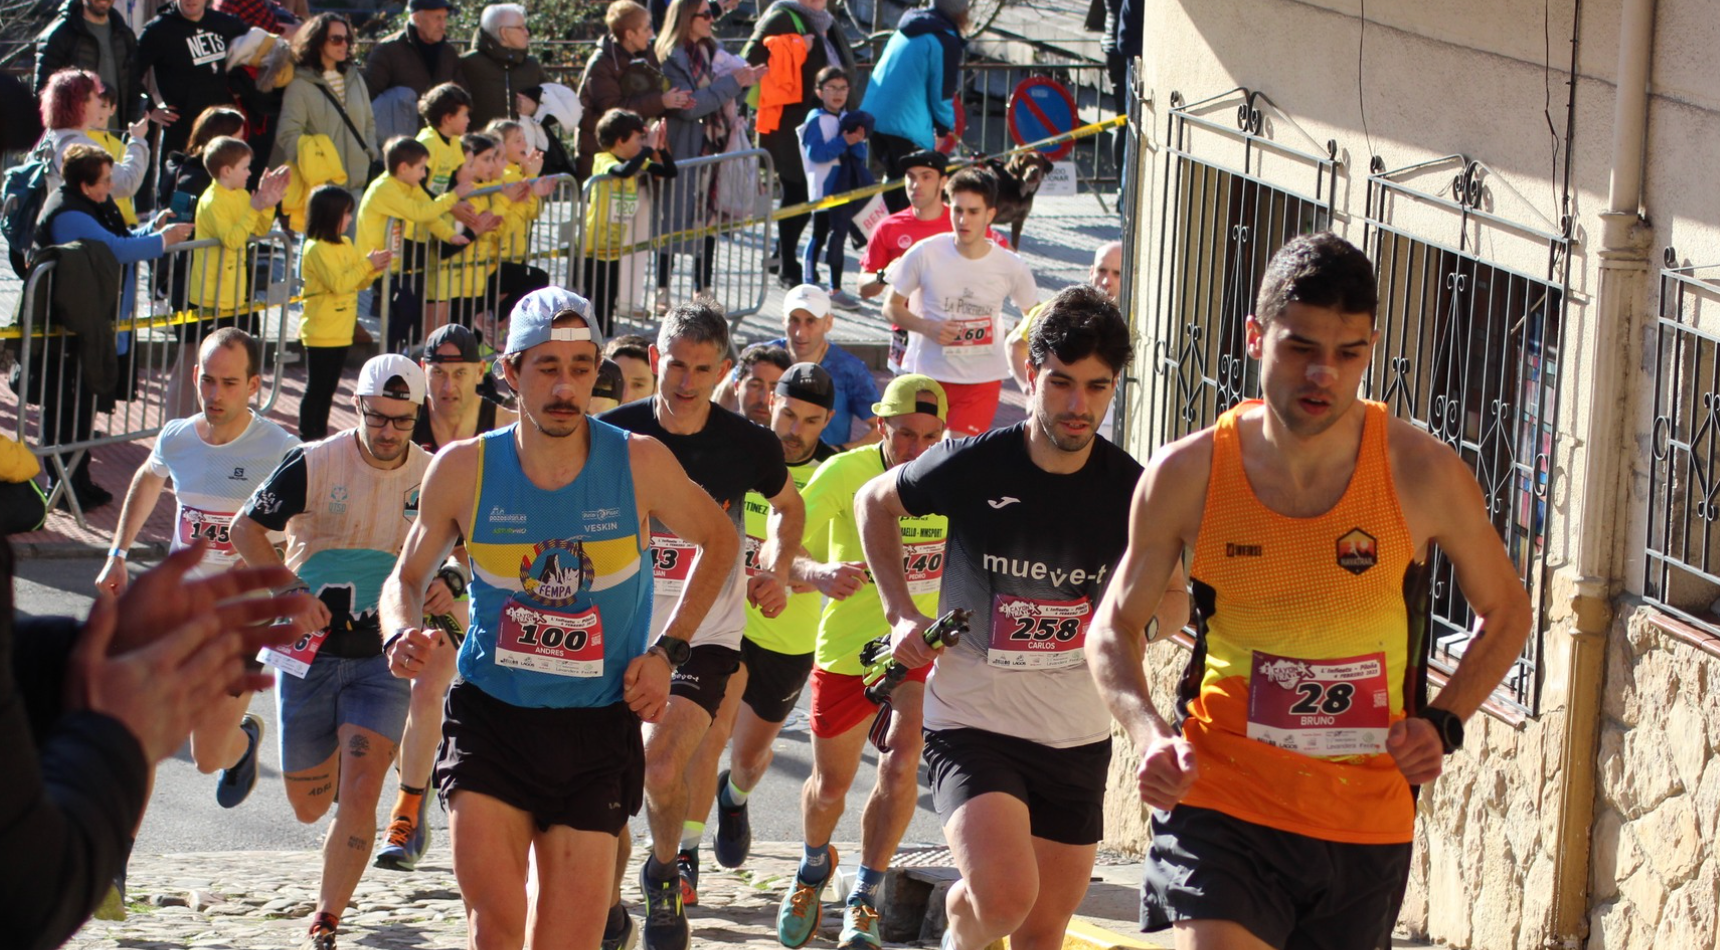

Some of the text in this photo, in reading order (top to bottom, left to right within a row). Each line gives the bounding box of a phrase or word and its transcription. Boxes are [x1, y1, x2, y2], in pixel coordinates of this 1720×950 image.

[186, 32, 225, 58] NETS
[744, 501, 769, 515] TINEZ
[190, 522, 229, 543] 145
[584, 522, 618, 532] VESKIN
[539, 585, 572, 598] FEMPA
[1010, 617, 1080, 642] 258
[517, 625, 589, 651] 100
[535, 647, 564, 657] ANDRES
[1028, 642, 1055, 650] CARLOS
[1288, 682, 1355, 715] 28
[1300, 716, 1335, 725] BRUNO
